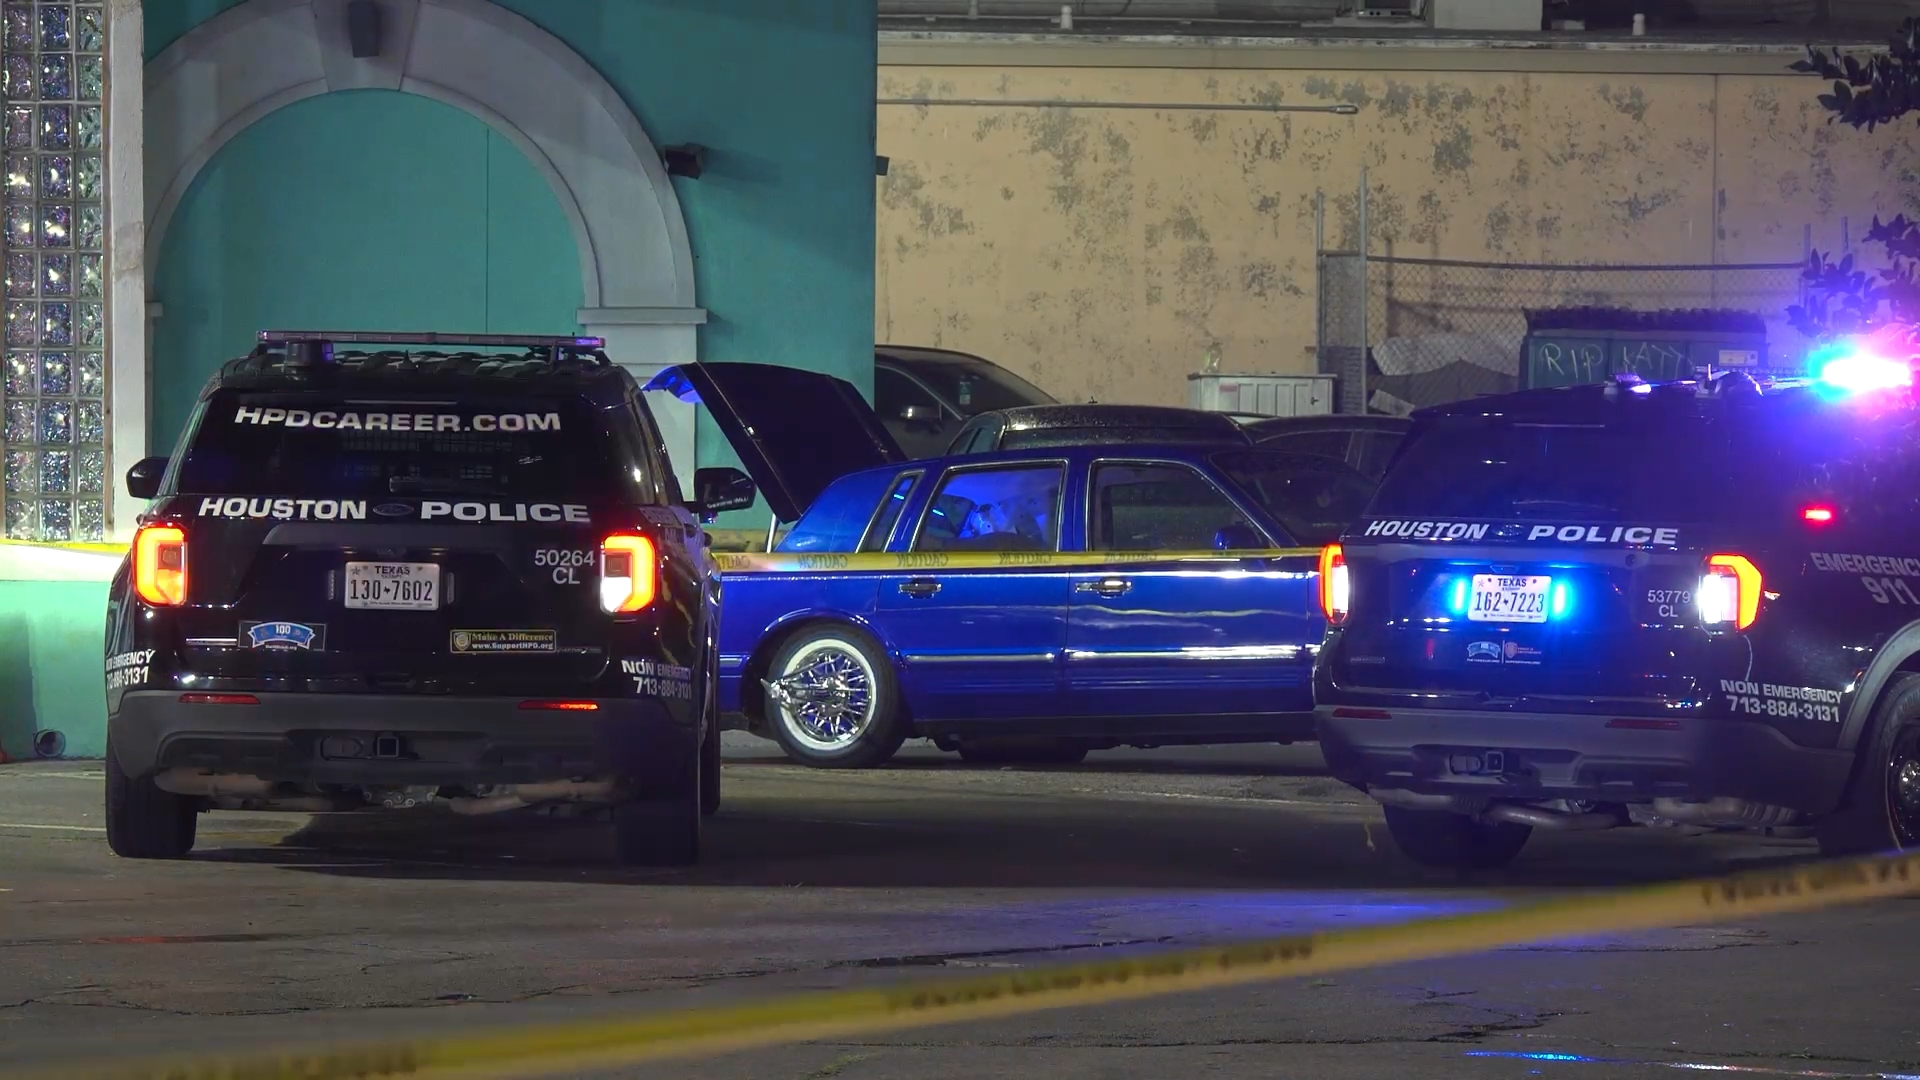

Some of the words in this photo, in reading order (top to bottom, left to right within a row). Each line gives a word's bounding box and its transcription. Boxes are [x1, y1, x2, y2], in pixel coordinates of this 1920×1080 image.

[1539, 343, 1604, 382] RIP
[234, 405, 562, 432] HPDCAREER.COM
[198, 497, 367, 520] HOUSTON
[420, 501, 591, 523] POLICE
[1364, 519, 1490, 540] HOUSTON
[1527, 525, 1679, 545] POLICE
[534, 549, 596, 567] 50264
[374, 565, 411, 575] TEXAS
[552, 566, 581, 584] CL
[1497, 578, 1527, 588] TEXAS
[1861, 576, 1920, 605] 911
[1647, 589, 1691, 604] 53779
[1658, 604, 1679, 618] CL
[275, 624, 291, 635] 100
[501, 633, 507, 641] A
[509, 632, 554, 641] Difference
[621, 659, 655, 676] NON
[1720, 679, 1760, 696] NON
[1762, 683, 1842, 704] EMERGENCY
[1726, 694, 1840, 723] 713-884-3131
